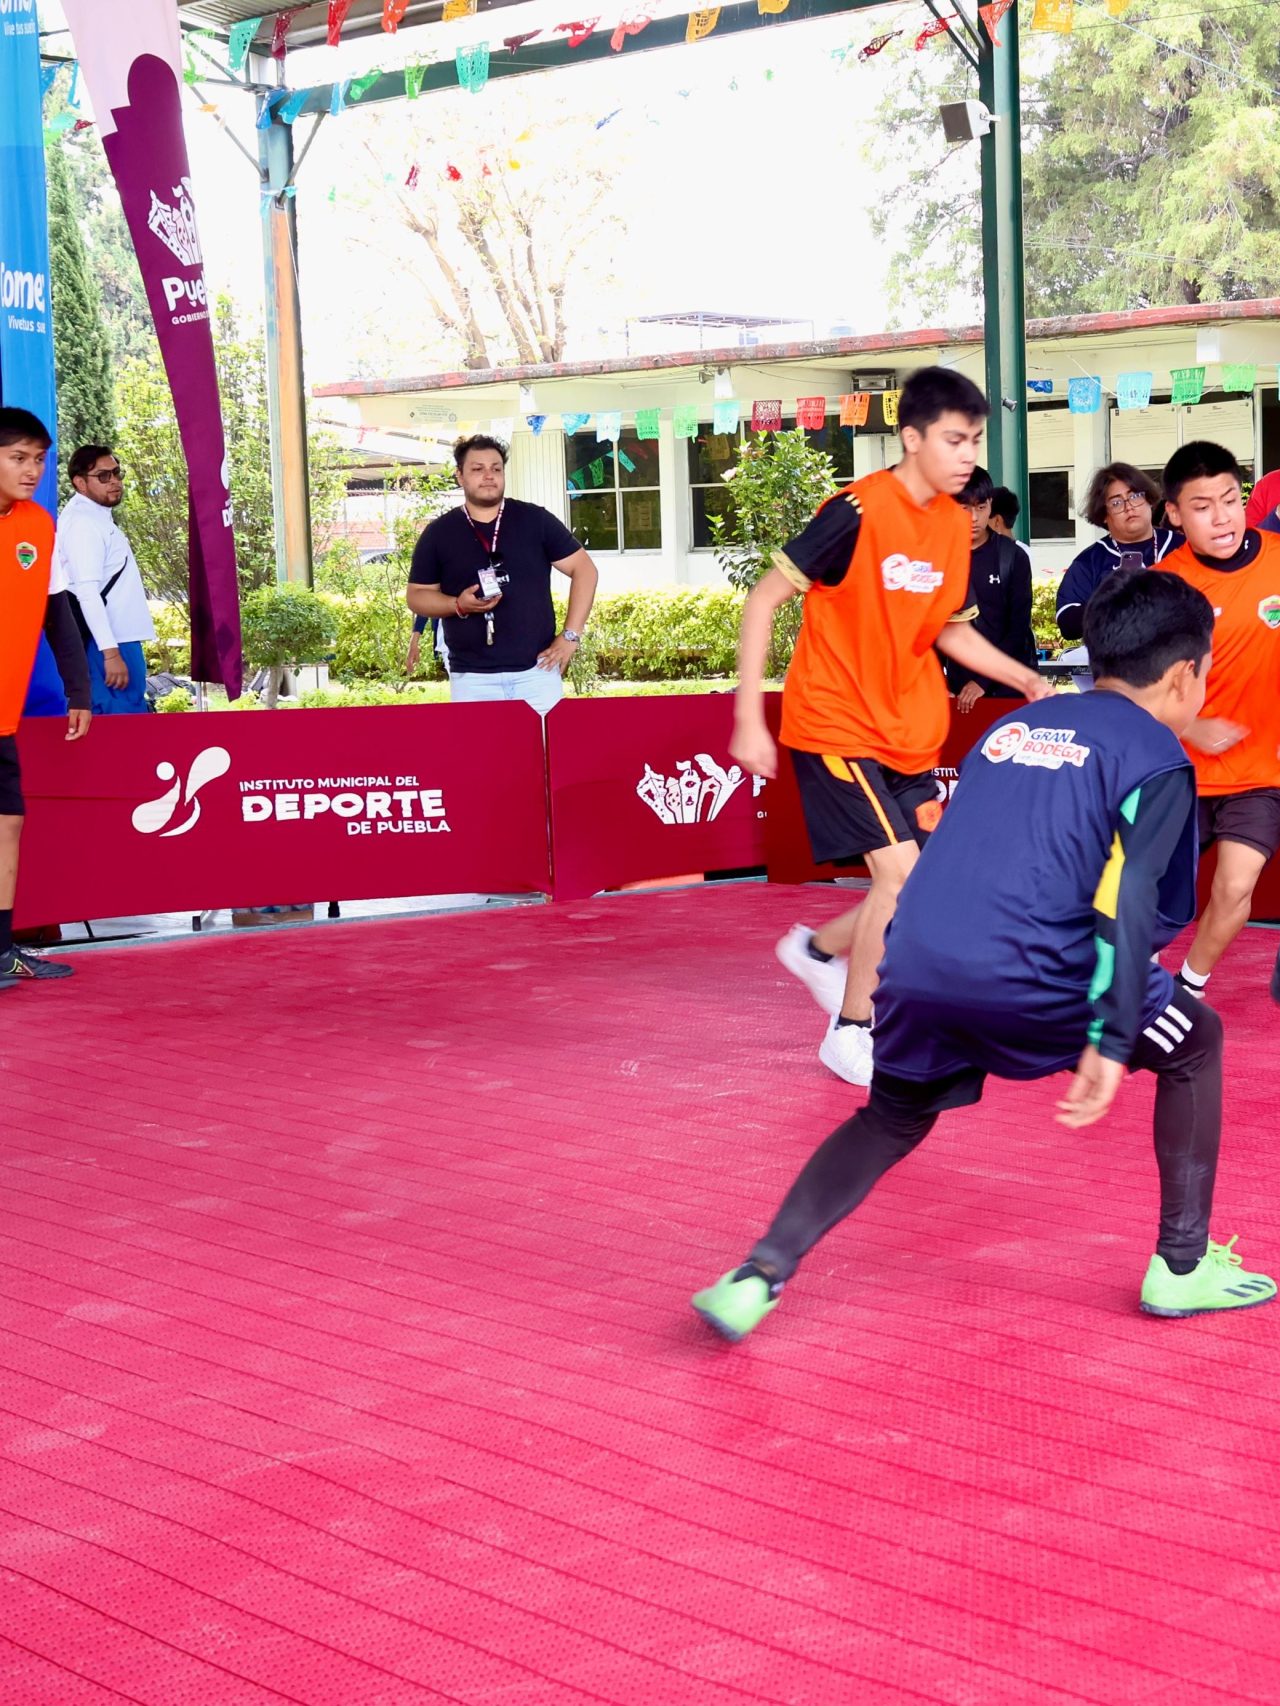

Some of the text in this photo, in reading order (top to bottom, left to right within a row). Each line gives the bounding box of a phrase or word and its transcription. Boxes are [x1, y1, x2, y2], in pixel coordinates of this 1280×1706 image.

[1031, 730, 1070, 744] GRAN
[1022, 740, 1082, 762] BODEGA
[239, 775, 420, 792] INSTITUTO MUNICIPAL DEL
[241, 789, 446, 822] DEPORTE
[347, 819, 451, 836] DE PUEBLA
